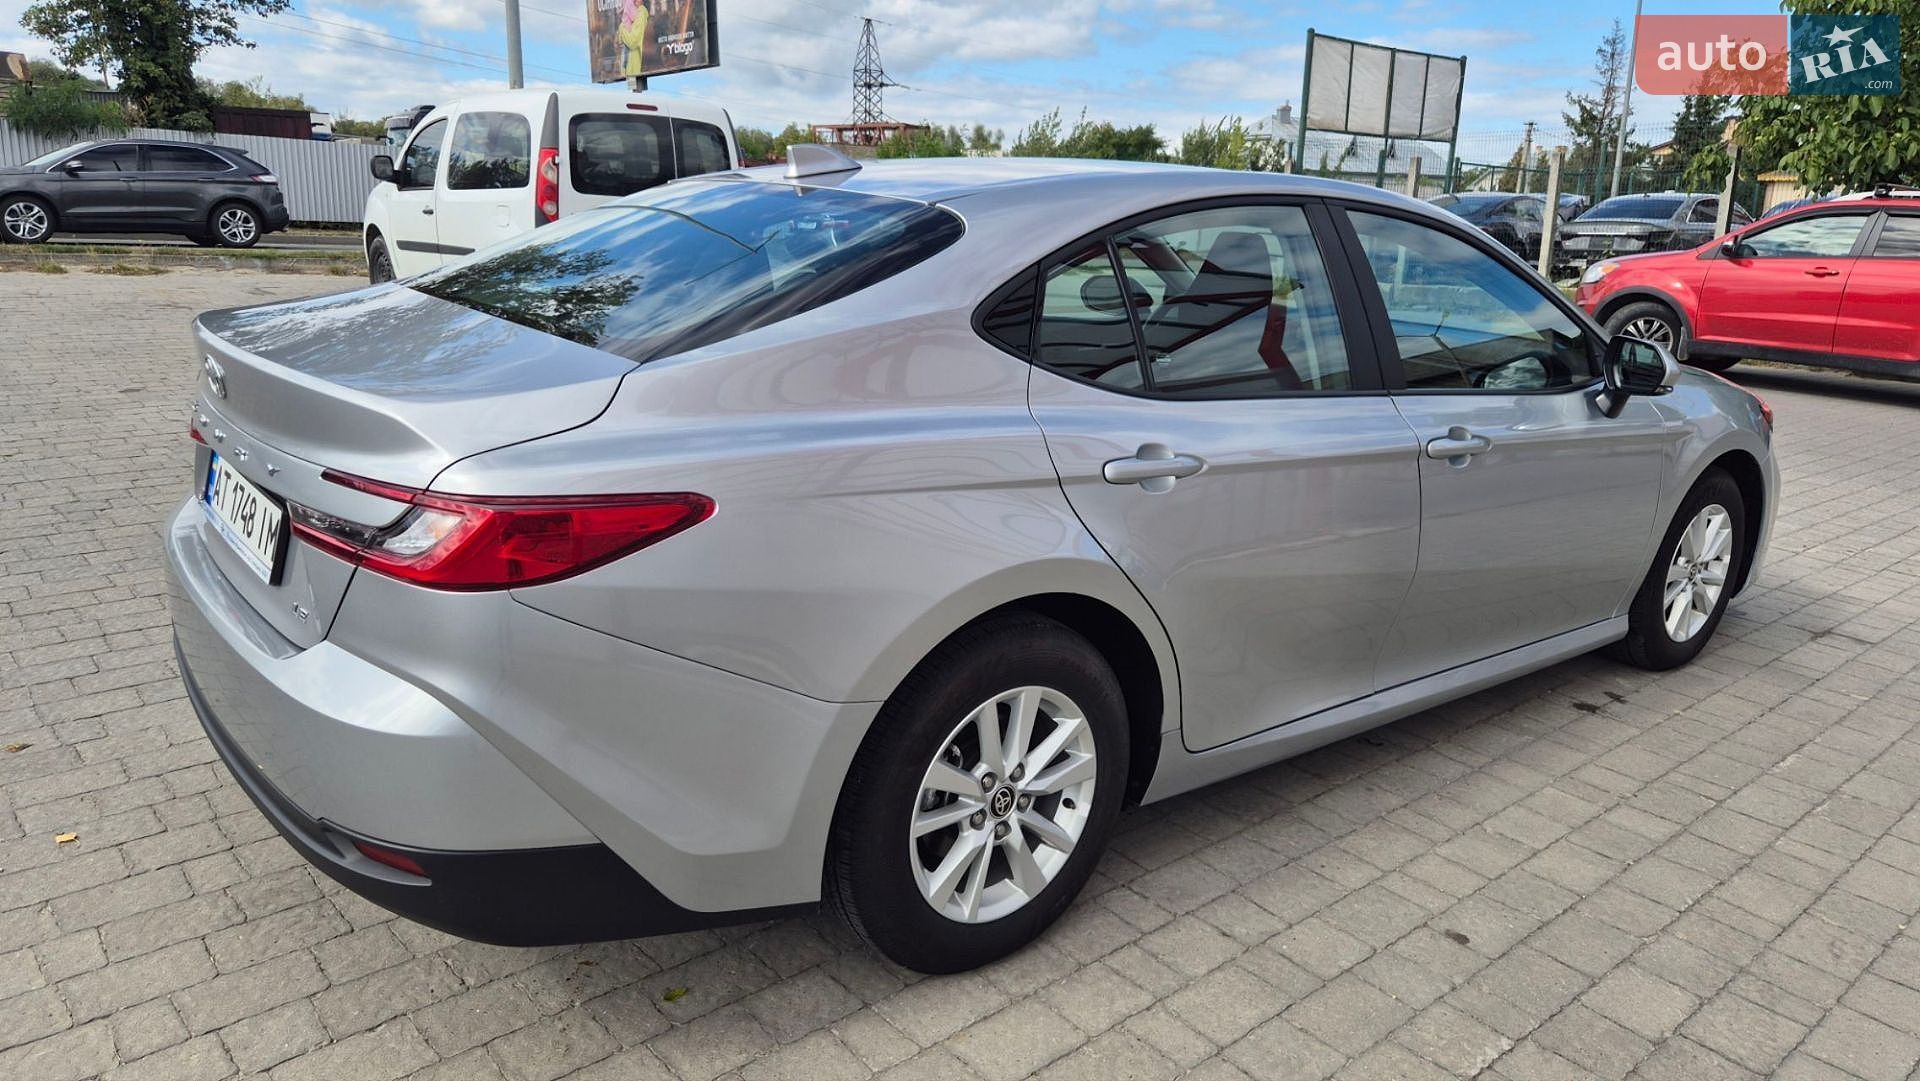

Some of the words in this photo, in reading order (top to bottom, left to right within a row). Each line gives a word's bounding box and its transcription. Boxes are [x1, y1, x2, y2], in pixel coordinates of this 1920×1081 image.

[213, 465, 232, 511] AT
[230, 481, 257, 538] 1748
[258, 506, 280, 562] IM
